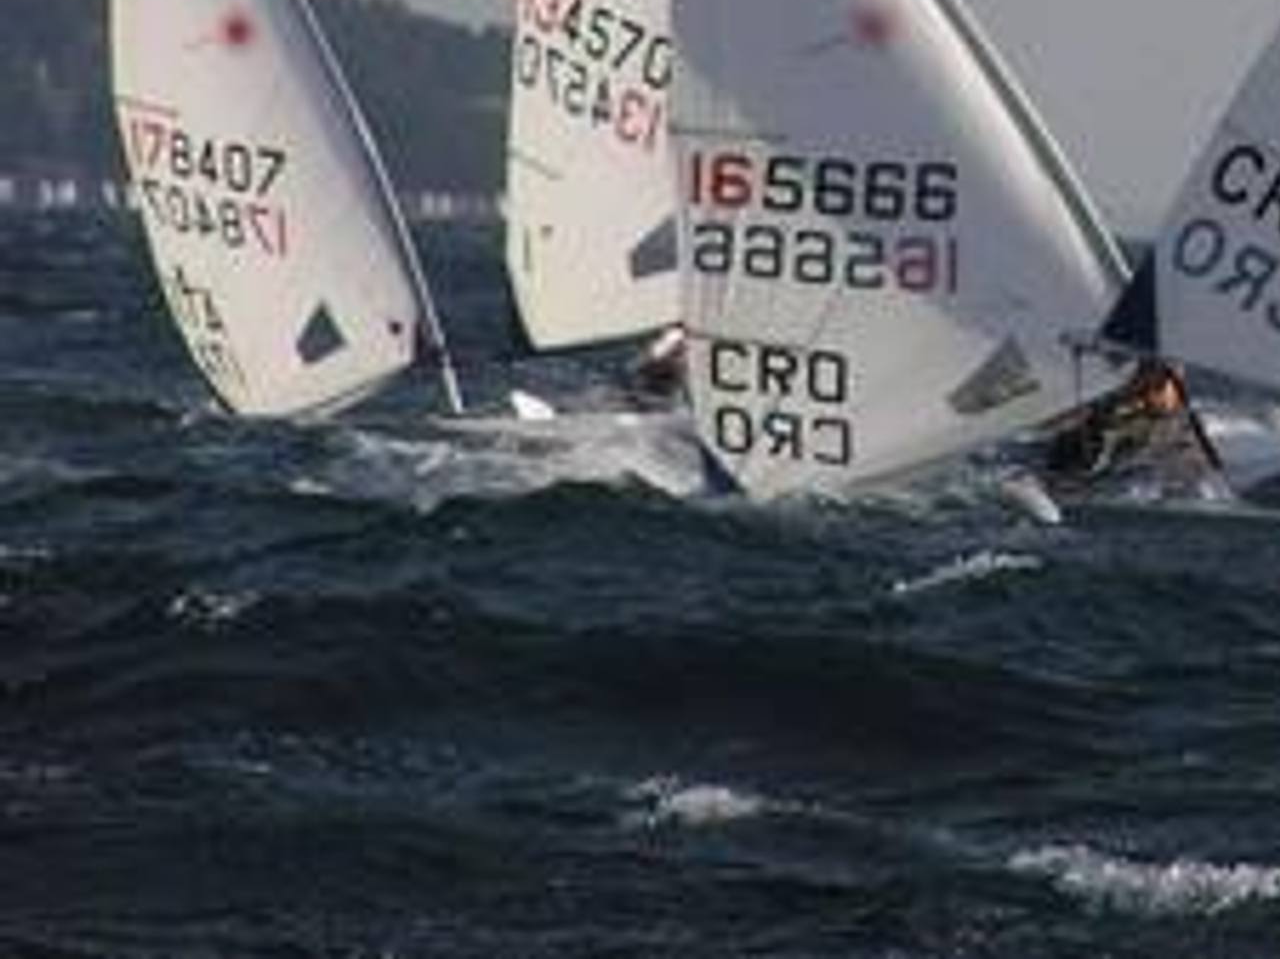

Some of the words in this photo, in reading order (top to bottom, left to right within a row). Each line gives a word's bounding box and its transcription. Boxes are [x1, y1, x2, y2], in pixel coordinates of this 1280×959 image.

[129, 118, 288, 198] 178407
[687, 151, 958, 222] 165666
[710, 341, 848, 405] CRO
